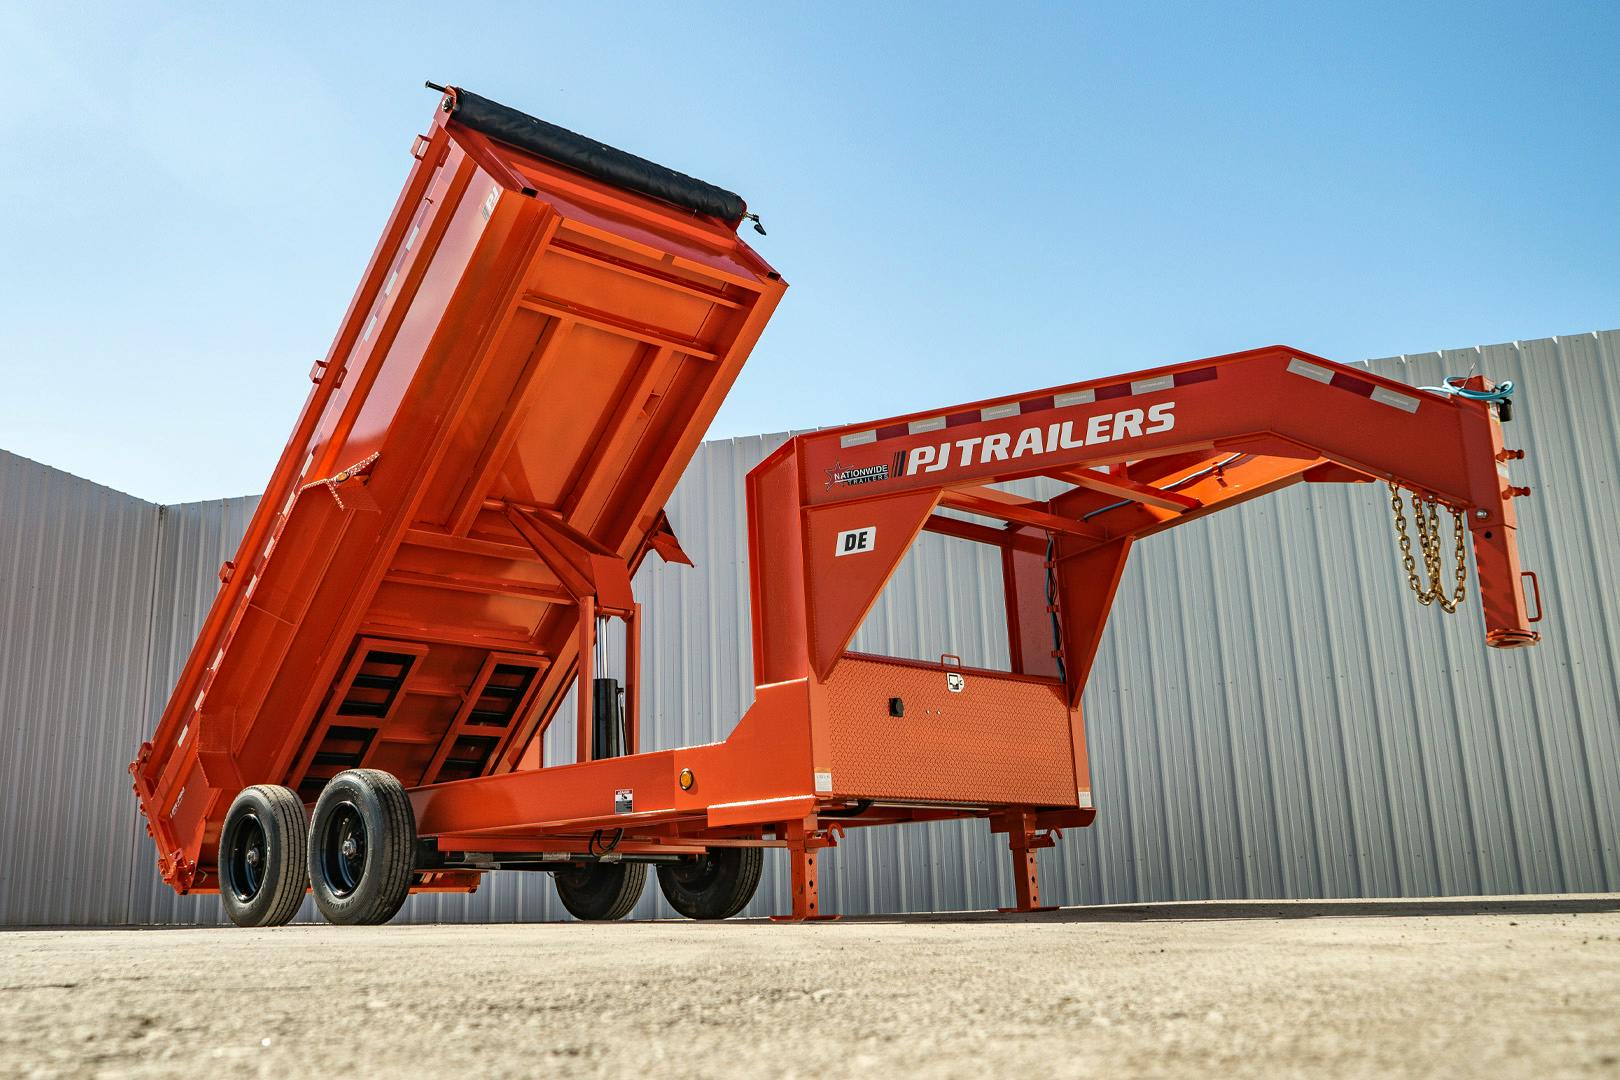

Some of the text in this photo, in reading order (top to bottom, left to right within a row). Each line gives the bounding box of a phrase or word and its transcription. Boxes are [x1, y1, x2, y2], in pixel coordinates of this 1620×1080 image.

[956, 401, 1175, 467] TRAILERS
[834, 464, 888, 480] NATIONWIDE
[848, 473, 889, 486] TRAILERS
[844, 531, 868, 552] DE
